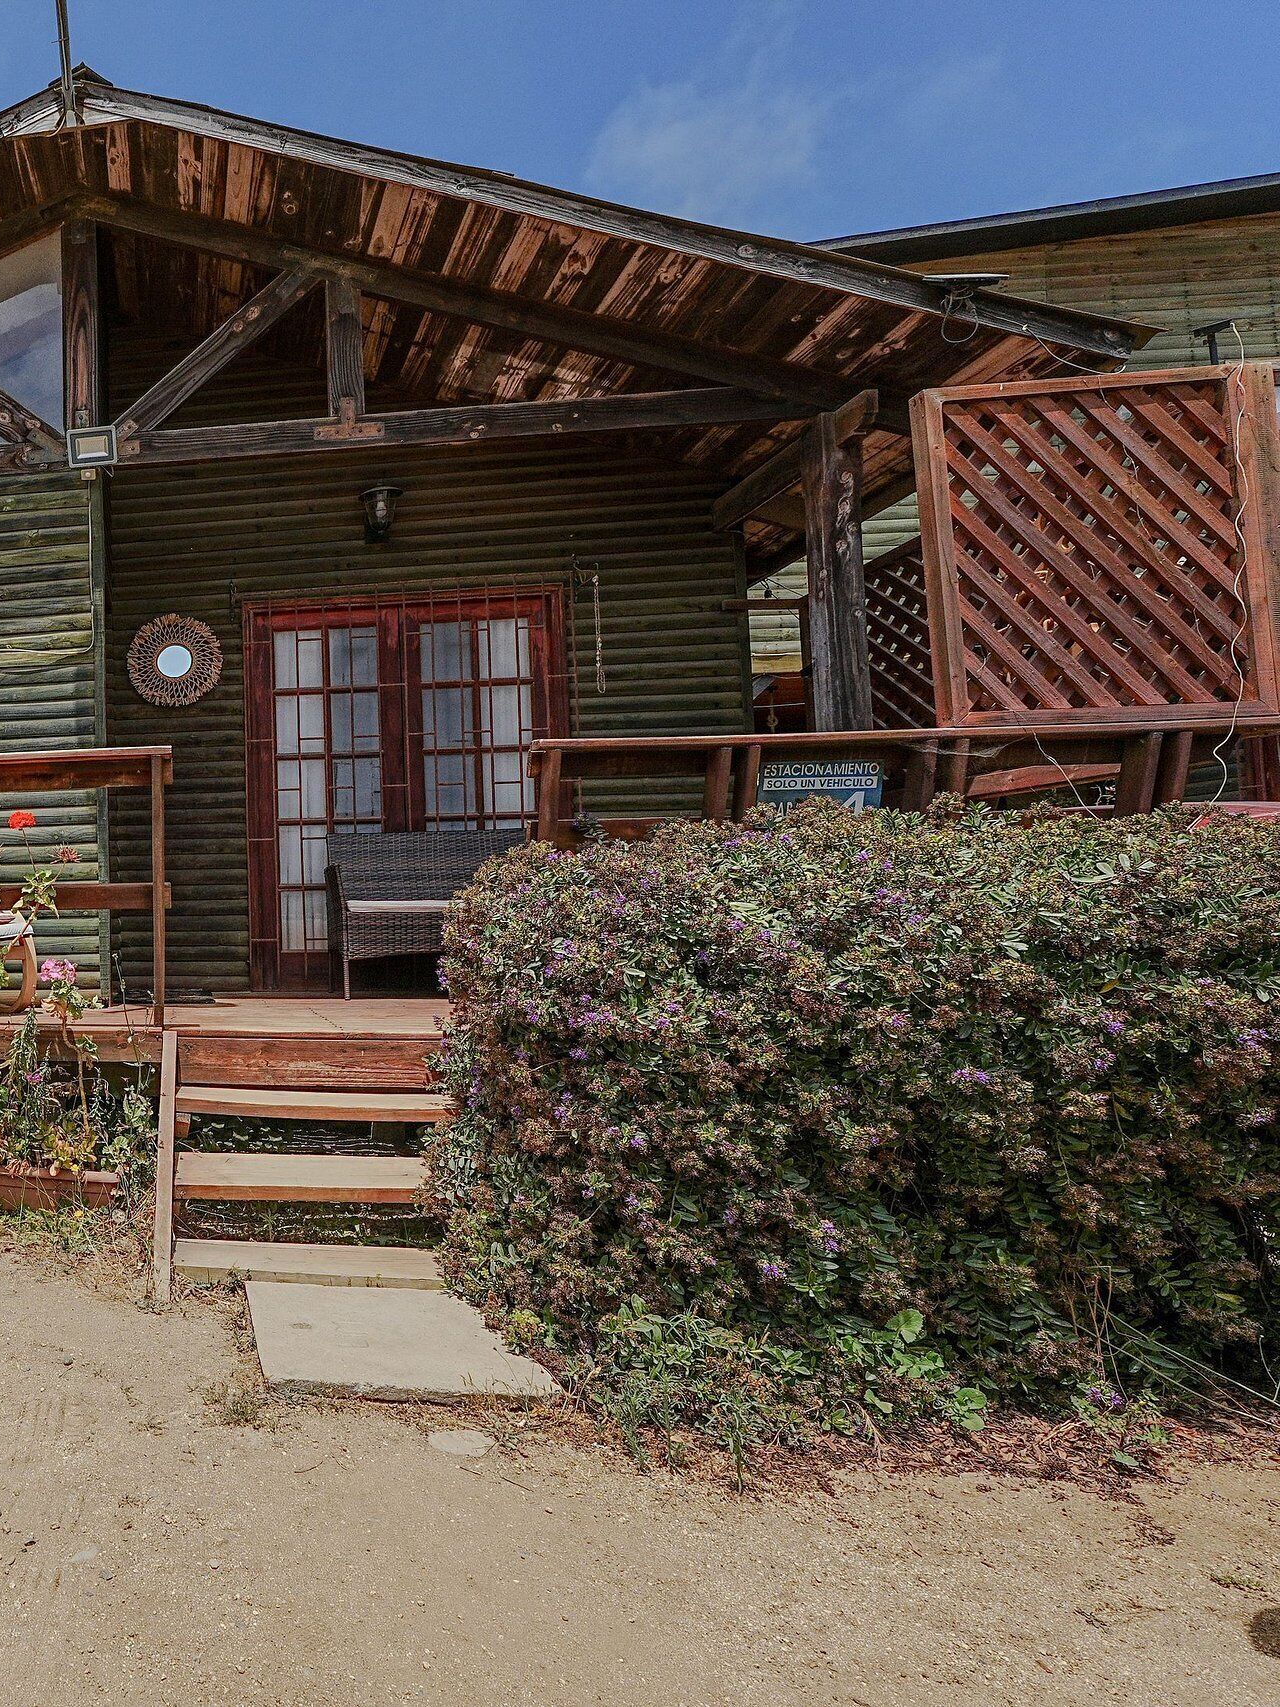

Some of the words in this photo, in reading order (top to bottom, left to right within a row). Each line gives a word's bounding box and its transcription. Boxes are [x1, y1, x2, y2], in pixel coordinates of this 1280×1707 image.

[763, 762, 880, 777] ESTACIONAMIENTO
[766, 779, 798, 789] SOLO
[800, 779, 816, 788] UN
[819, 778, 874, 788] VEHICULO
